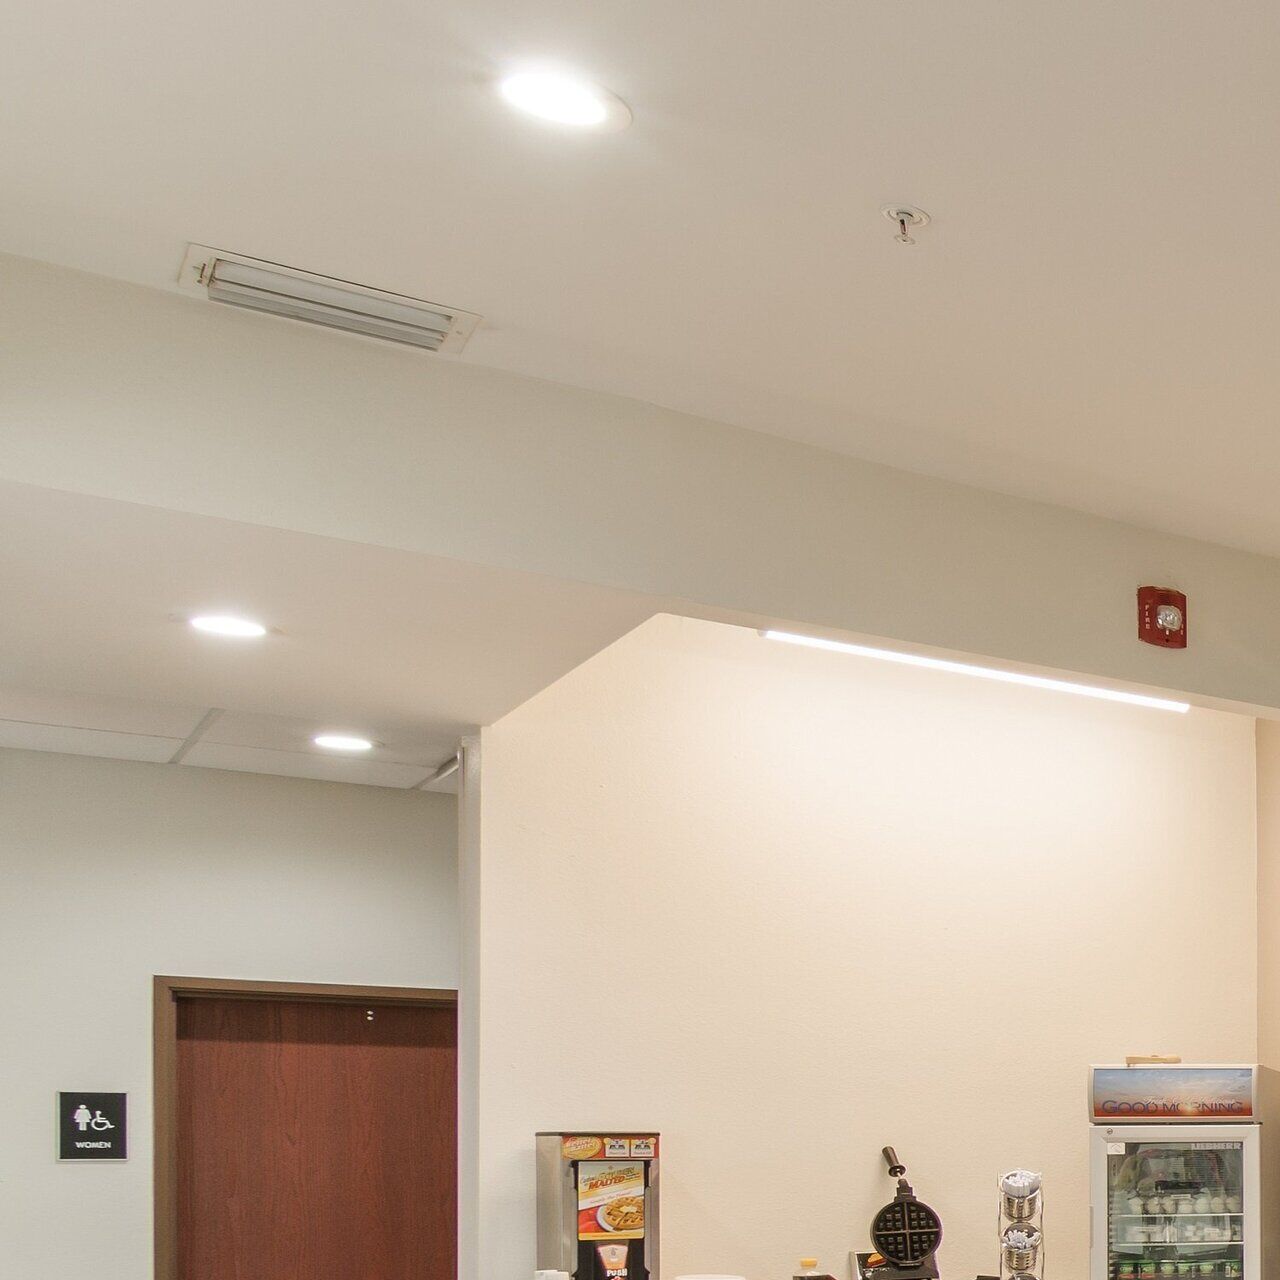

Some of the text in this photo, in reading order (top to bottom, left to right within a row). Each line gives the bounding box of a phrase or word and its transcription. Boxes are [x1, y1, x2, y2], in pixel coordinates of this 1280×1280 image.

[1102, 1100, 1159, 1114] GOOD
[1163, 1101, 1244, 1114] MORNING
[75, 1141, 112, 1149] WOMEN
[589, 1175, 626, 1190] MALTED
[606, 1268, 628, 1277] PUSH
